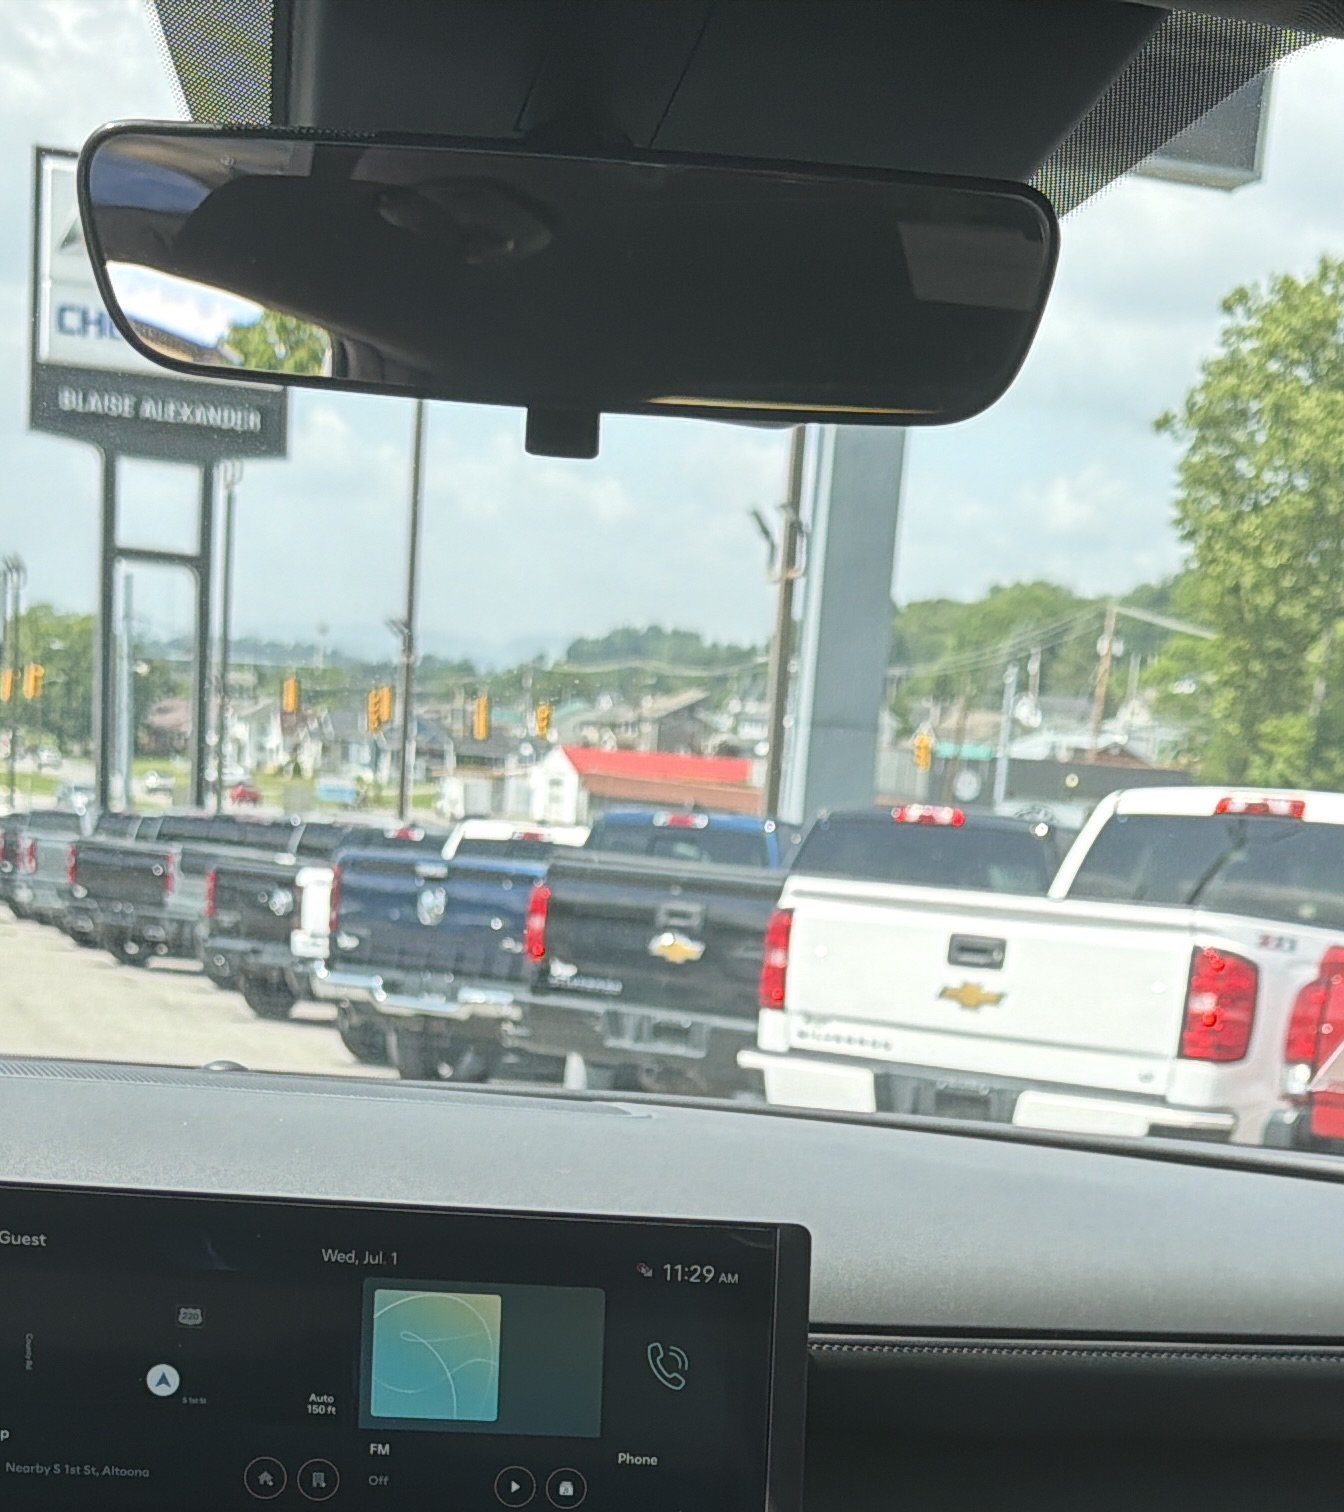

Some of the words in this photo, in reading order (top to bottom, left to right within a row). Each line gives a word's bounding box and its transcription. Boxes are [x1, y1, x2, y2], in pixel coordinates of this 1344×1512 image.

[139, 396, 262, 432] ALEXANDER
[322, 1248, 358, 1266] Wed,
[363, 1250, 387, 1265] Jul.
[391, 1251, 398, 1265] 1
[662, 1263, 715, 1284] 11:29
[718, 1273, 739, 1284] AM
[308, 1393, 335, 1404] Auto
[306, 1404, 325, 1415] 150
[326, 1404, 337, 1416] ft
[369, 1442, 391, 1456] FM
[617, 1452, 659, 1466] Phone
[5, 1461, 52, 1476] Nearby
[53, 1463, 61, 1474] S
[64, 1464, 80, 1475] 1st
[102, 1465, 150, 1478] Altoona
[368, 1474, 389, 1486] Off
